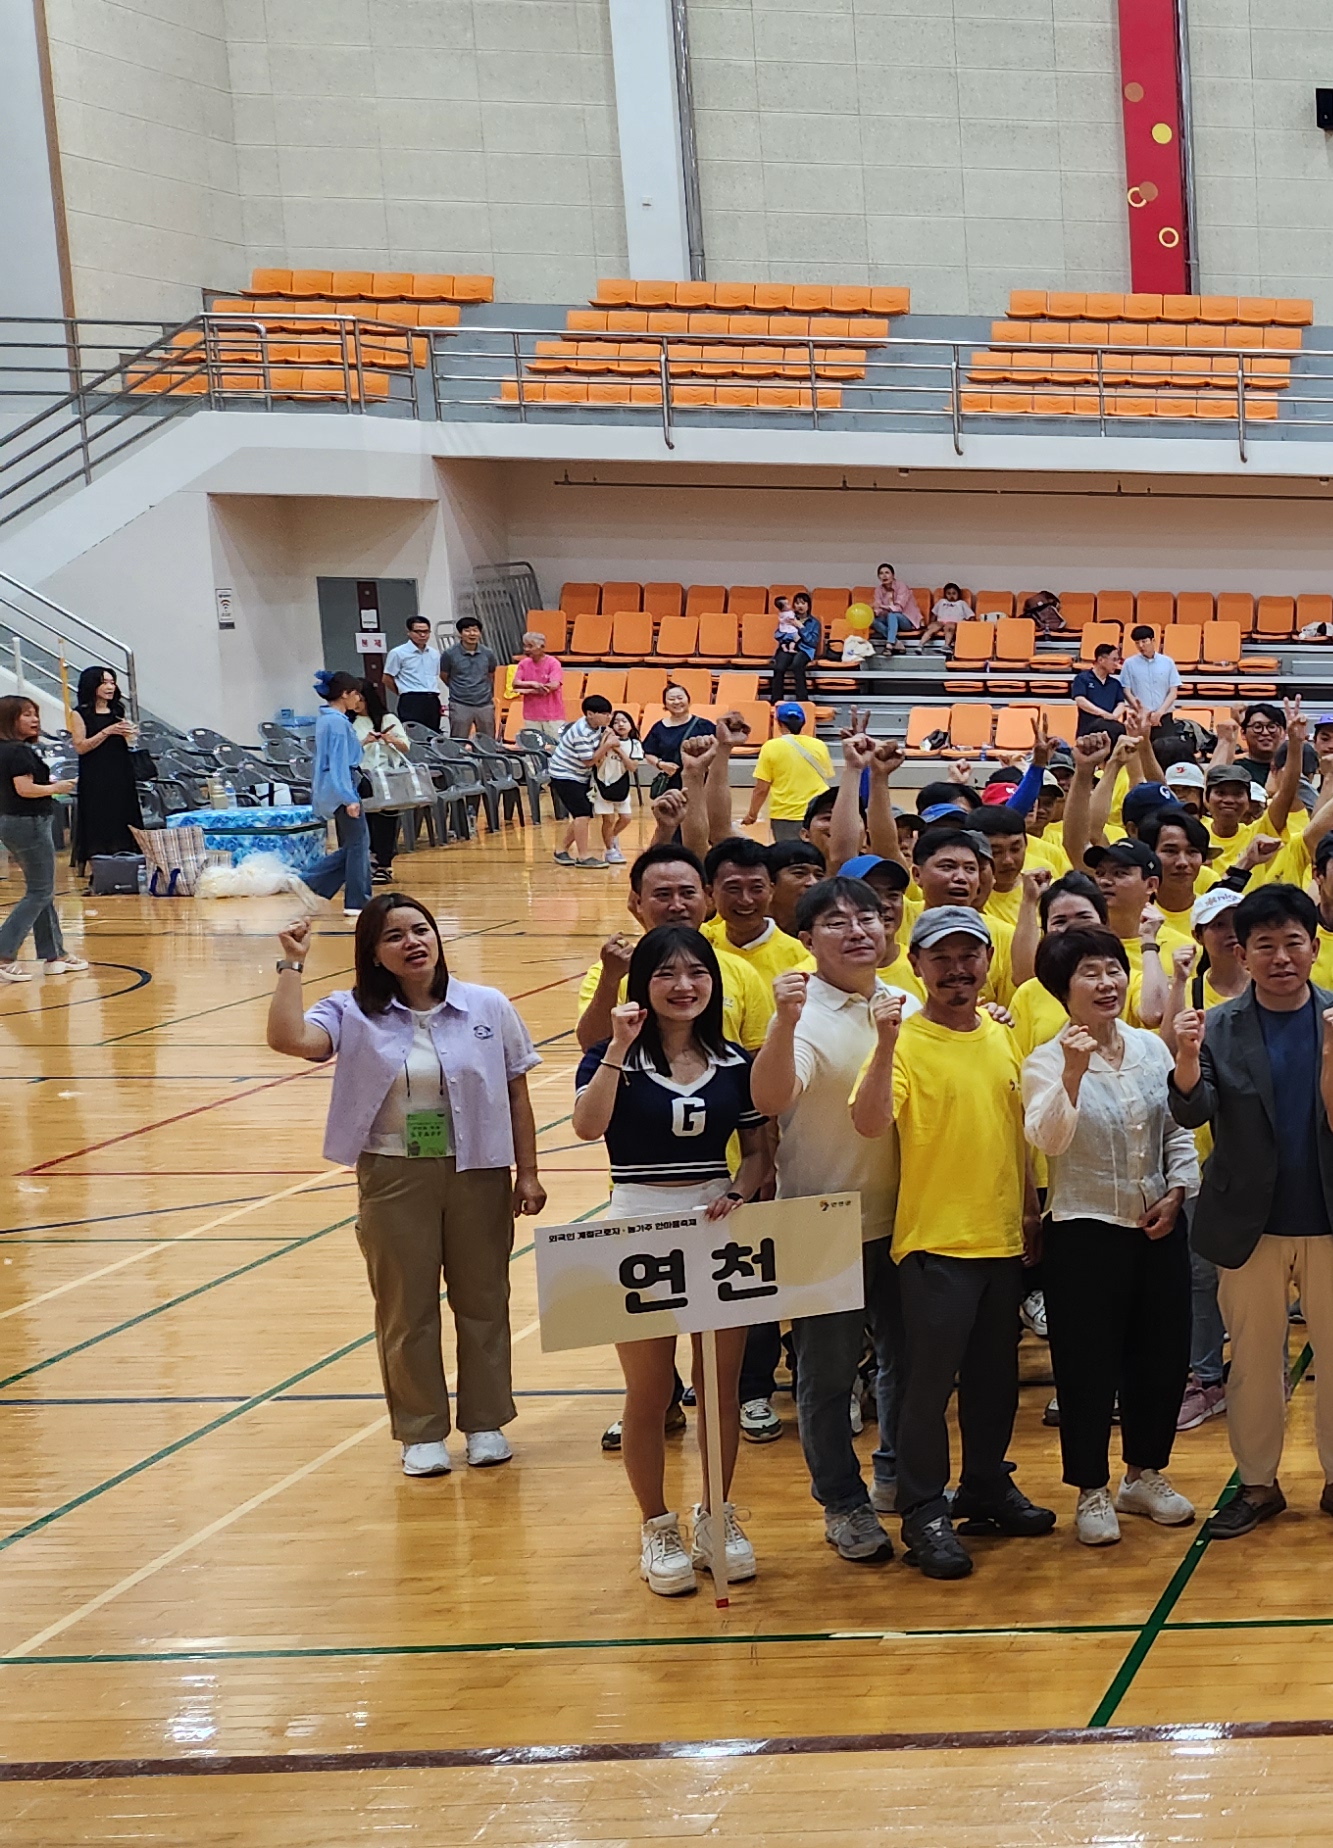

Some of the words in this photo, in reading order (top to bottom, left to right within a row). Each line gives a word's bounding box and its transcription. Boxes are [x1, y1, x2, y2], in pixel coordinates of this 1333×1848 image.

[671, 1096, 707, 1137] G
[548, 1232, 576, 1243] 외국인
[577, 1227, 621, 1240] 계절근로자
[627, 1223, 653, 1234] 농가주
[619, 1237, 778, 1314] 연천
